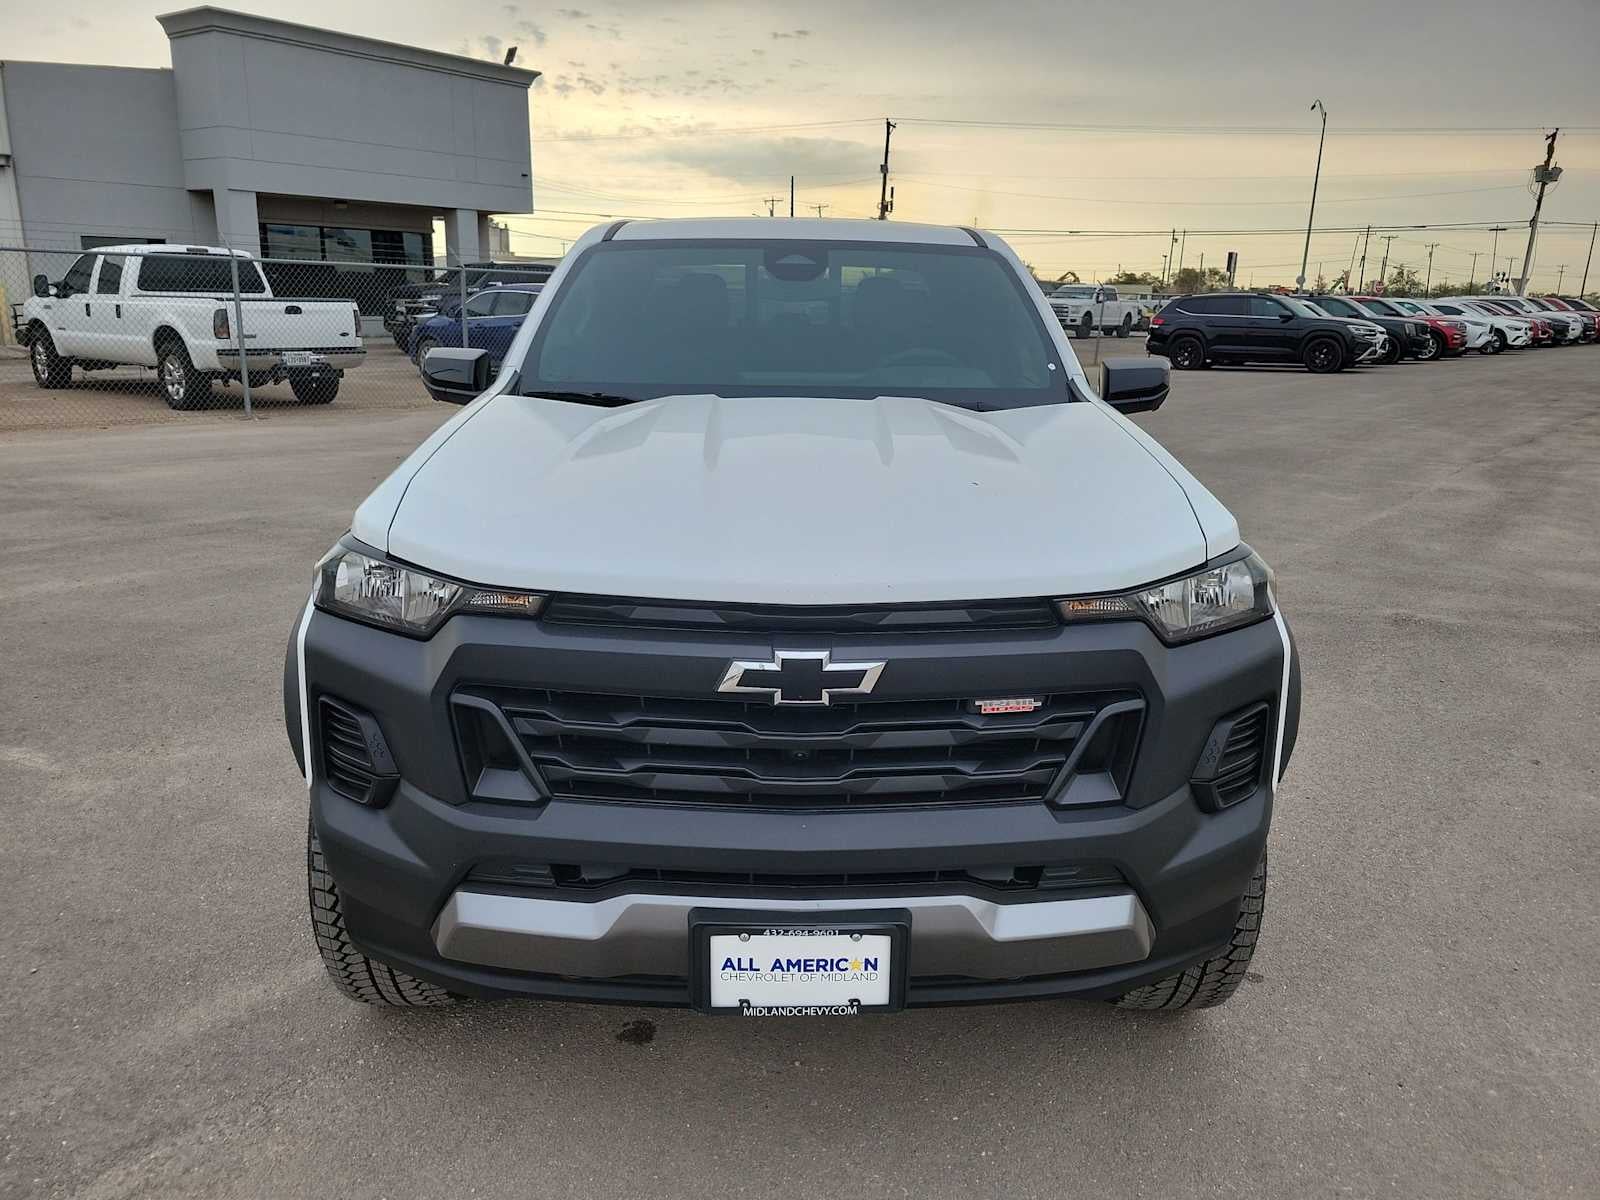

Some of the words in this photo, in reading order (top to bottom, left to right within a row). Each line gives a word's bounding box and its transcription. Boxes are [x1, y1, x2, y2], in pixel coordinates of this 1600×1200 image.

[721, 958, 760, 972] ALL
[770, 958, 878, 973] AMERICN
[720, 972, 796, 982] CHEVROLET
[799, 973, 817, 982] OF
[820, 972, 878, 982] MIDLAND
[743, 1006, 858, 1017] MIDLANDCHEVY.COM
